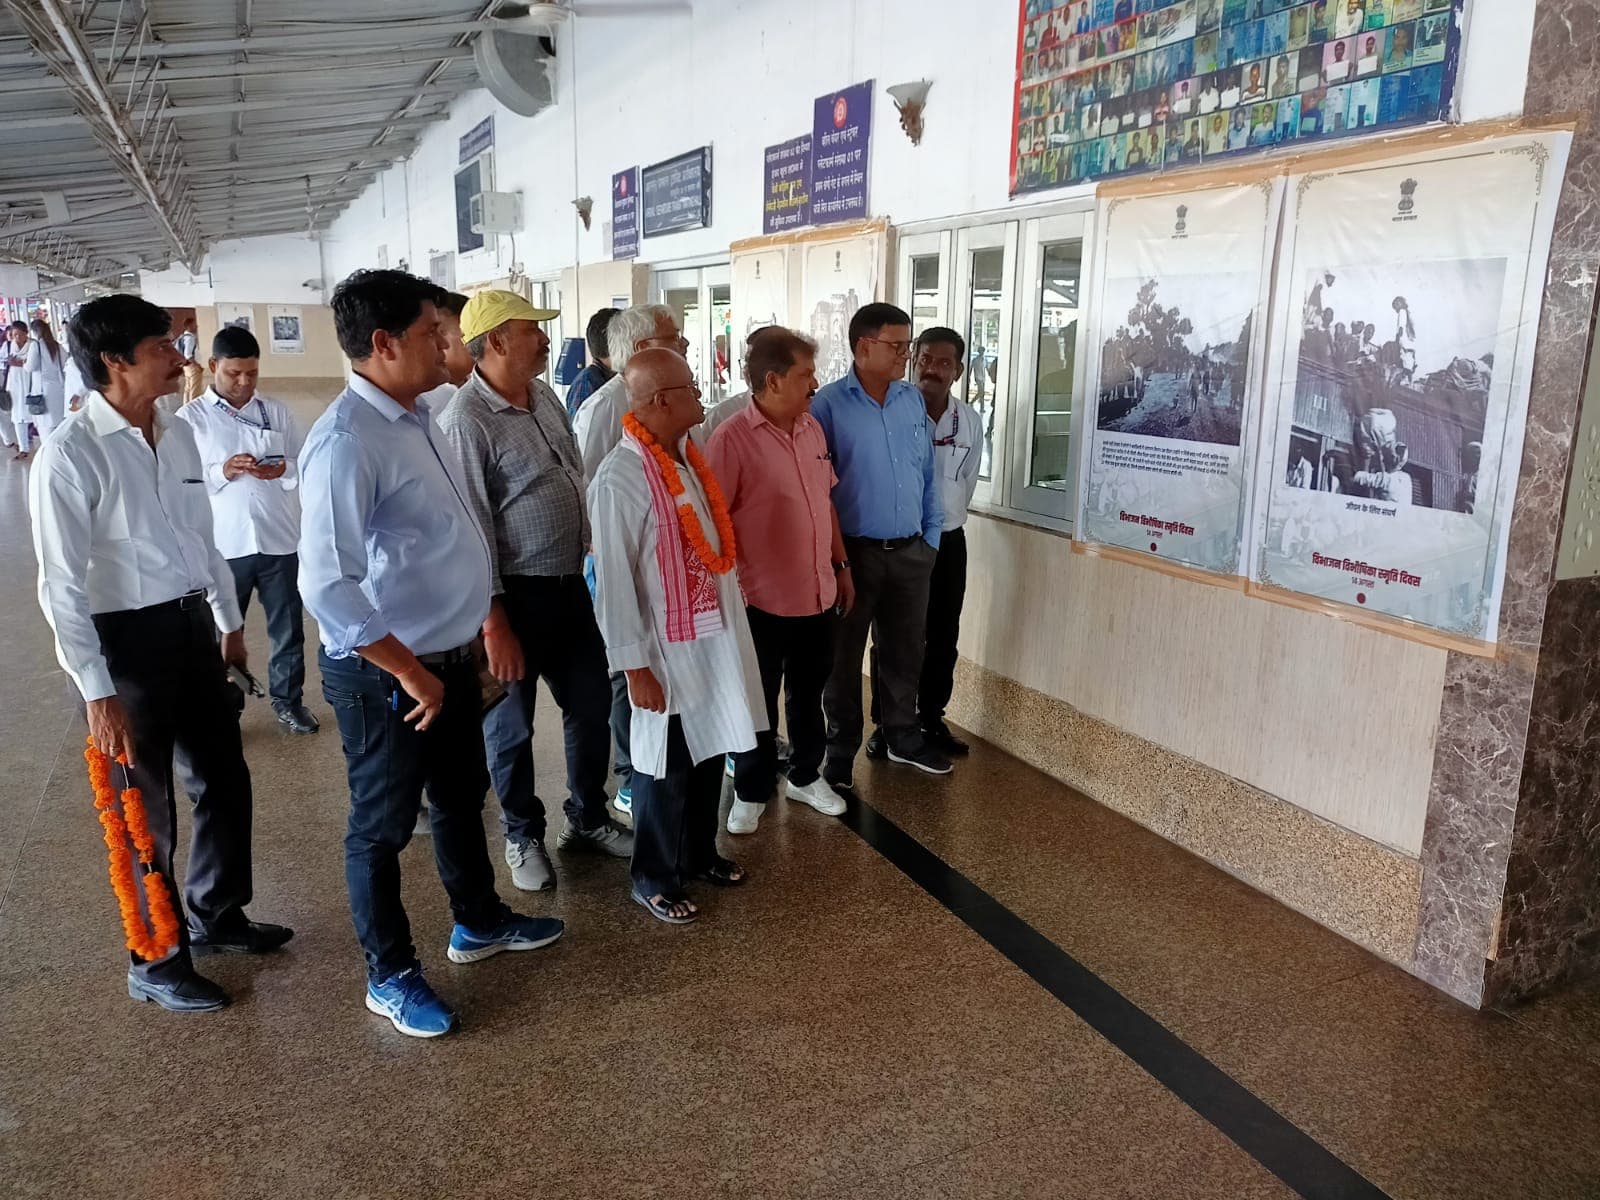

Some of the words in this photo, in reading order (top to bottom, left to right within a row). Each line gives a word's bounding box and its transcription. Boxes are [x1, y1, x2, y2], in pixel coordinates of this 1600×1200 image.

[1178, 522, 1194, 536] दिवस
[1312, 552, 1341, 570] विभाजन
[1342, 558, 1377, 578] विभीषिका
[1377, 568, 1398, 585] स्मृति
[1399, 570, 1421, 587] दिवस
